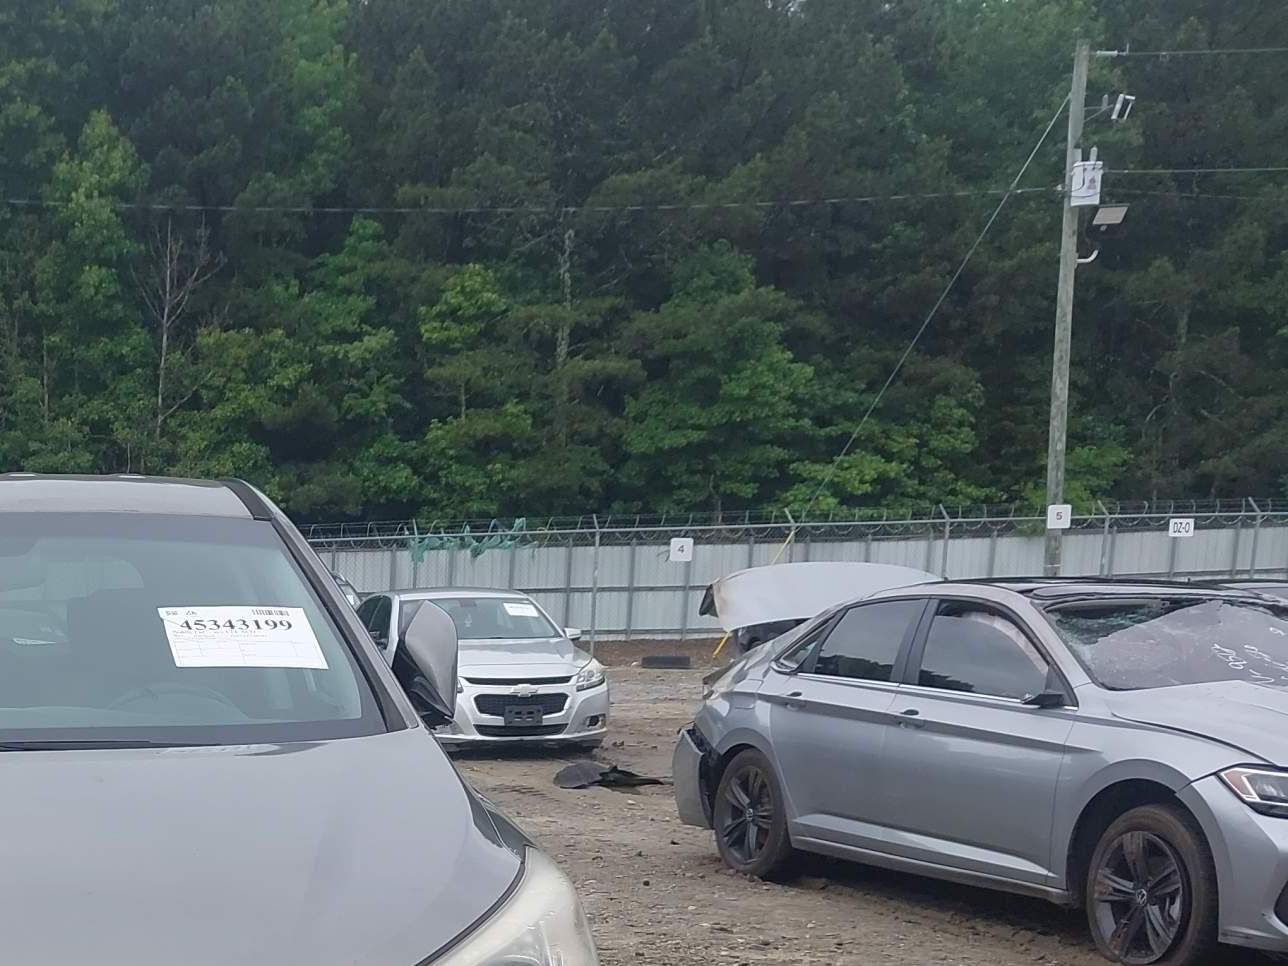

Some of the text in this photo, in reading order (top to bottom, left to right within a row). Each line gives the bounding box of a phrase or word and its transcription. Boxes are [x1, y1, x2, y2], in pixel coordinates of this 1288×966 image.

[1056, 512, 1063, 520] 5
[678, 545, 684, 553] 4
[179, 619, 293, 631] 45343199
